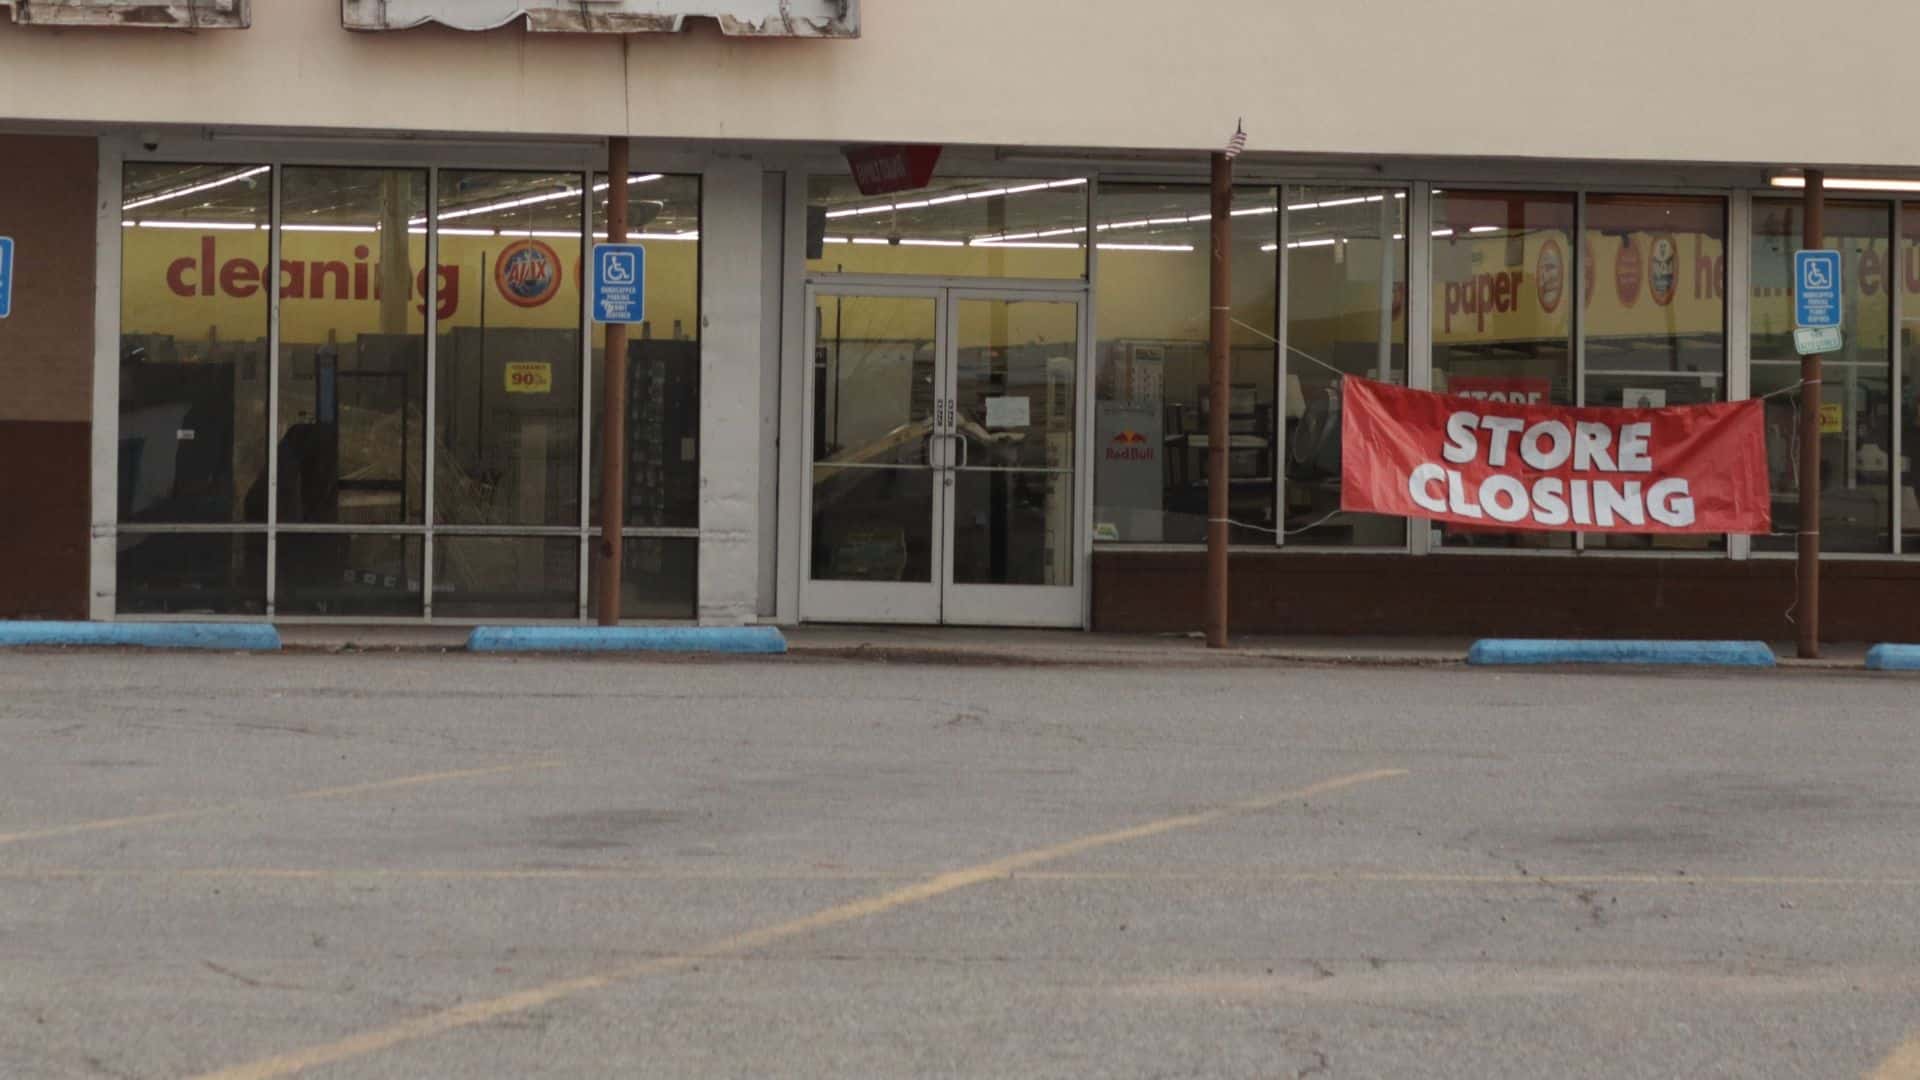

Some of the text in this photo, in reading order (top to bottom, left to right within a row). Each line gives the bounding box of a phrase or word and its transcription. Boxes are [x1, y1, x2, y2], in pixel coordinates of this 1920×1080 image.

[166, 236, 460, 320] cleanig
[1445, 271, 1523, 334] paper
[1442, 411, 1652, 472] STORE
[1408, 463, 1696, 527] CLOSING
